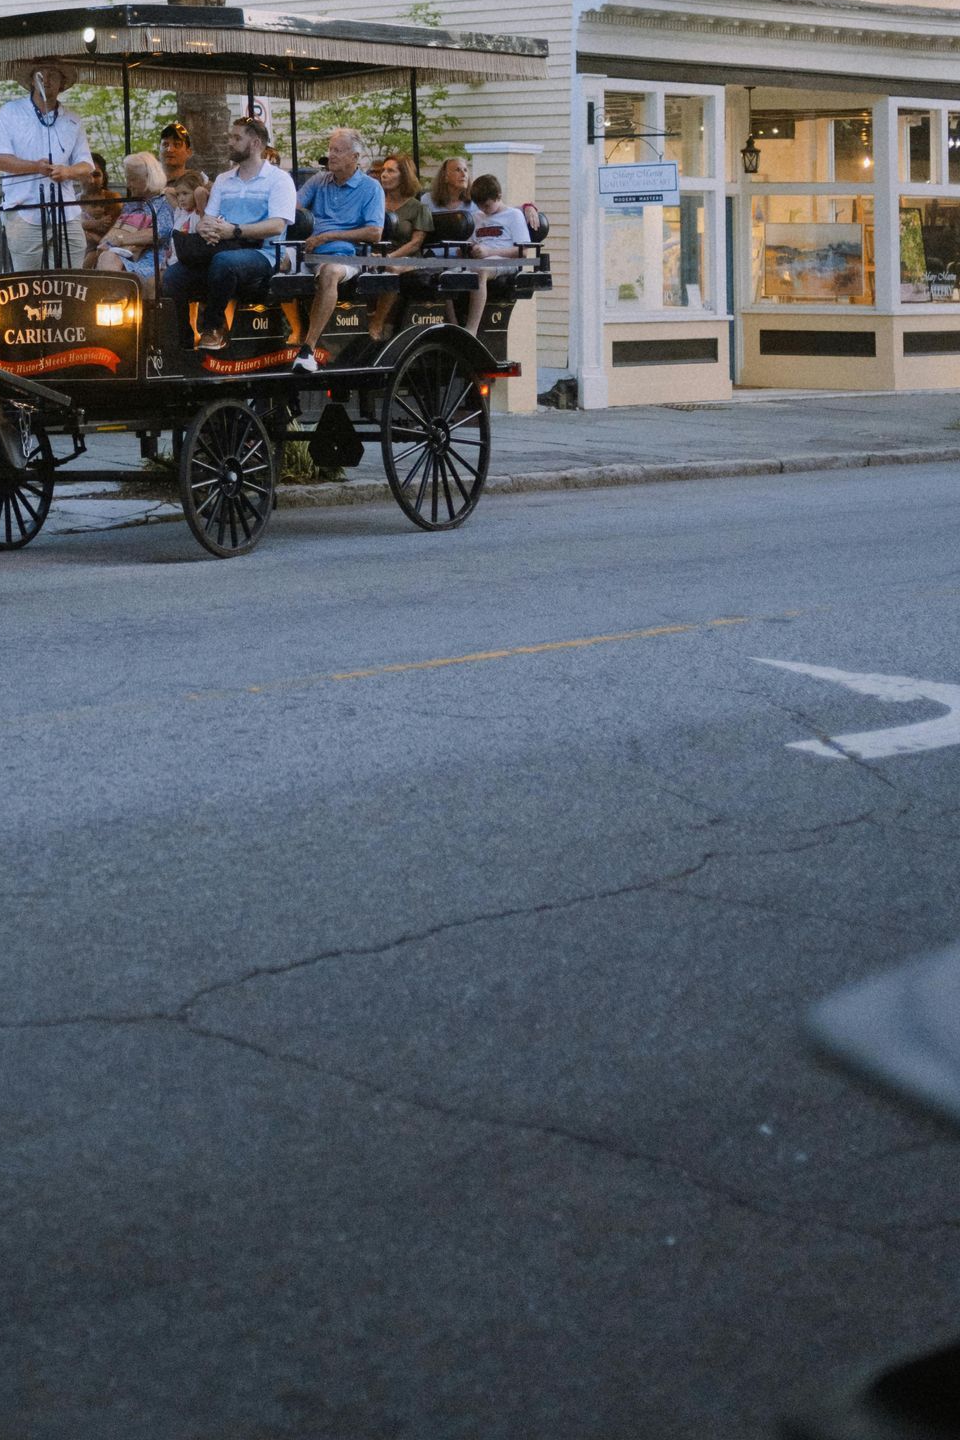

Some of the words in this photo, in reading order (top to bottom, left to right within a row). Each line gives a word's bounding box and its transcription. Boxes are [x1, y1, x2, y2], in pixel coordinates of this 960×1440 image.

[32, 280, 89, 302] SOUTH
[252, 317, 269, 330] Old
[335, 314, 359, 327] South
[411, 313, 445, 325] Carriage
[4, 327, 87, 345] CARRIAGE
[68, 352, 111, 363] Hospitality
[209, 359, 232, 372] Where
[234, 359, 261, 372] History
[264, 354, 285, 365] Meets
